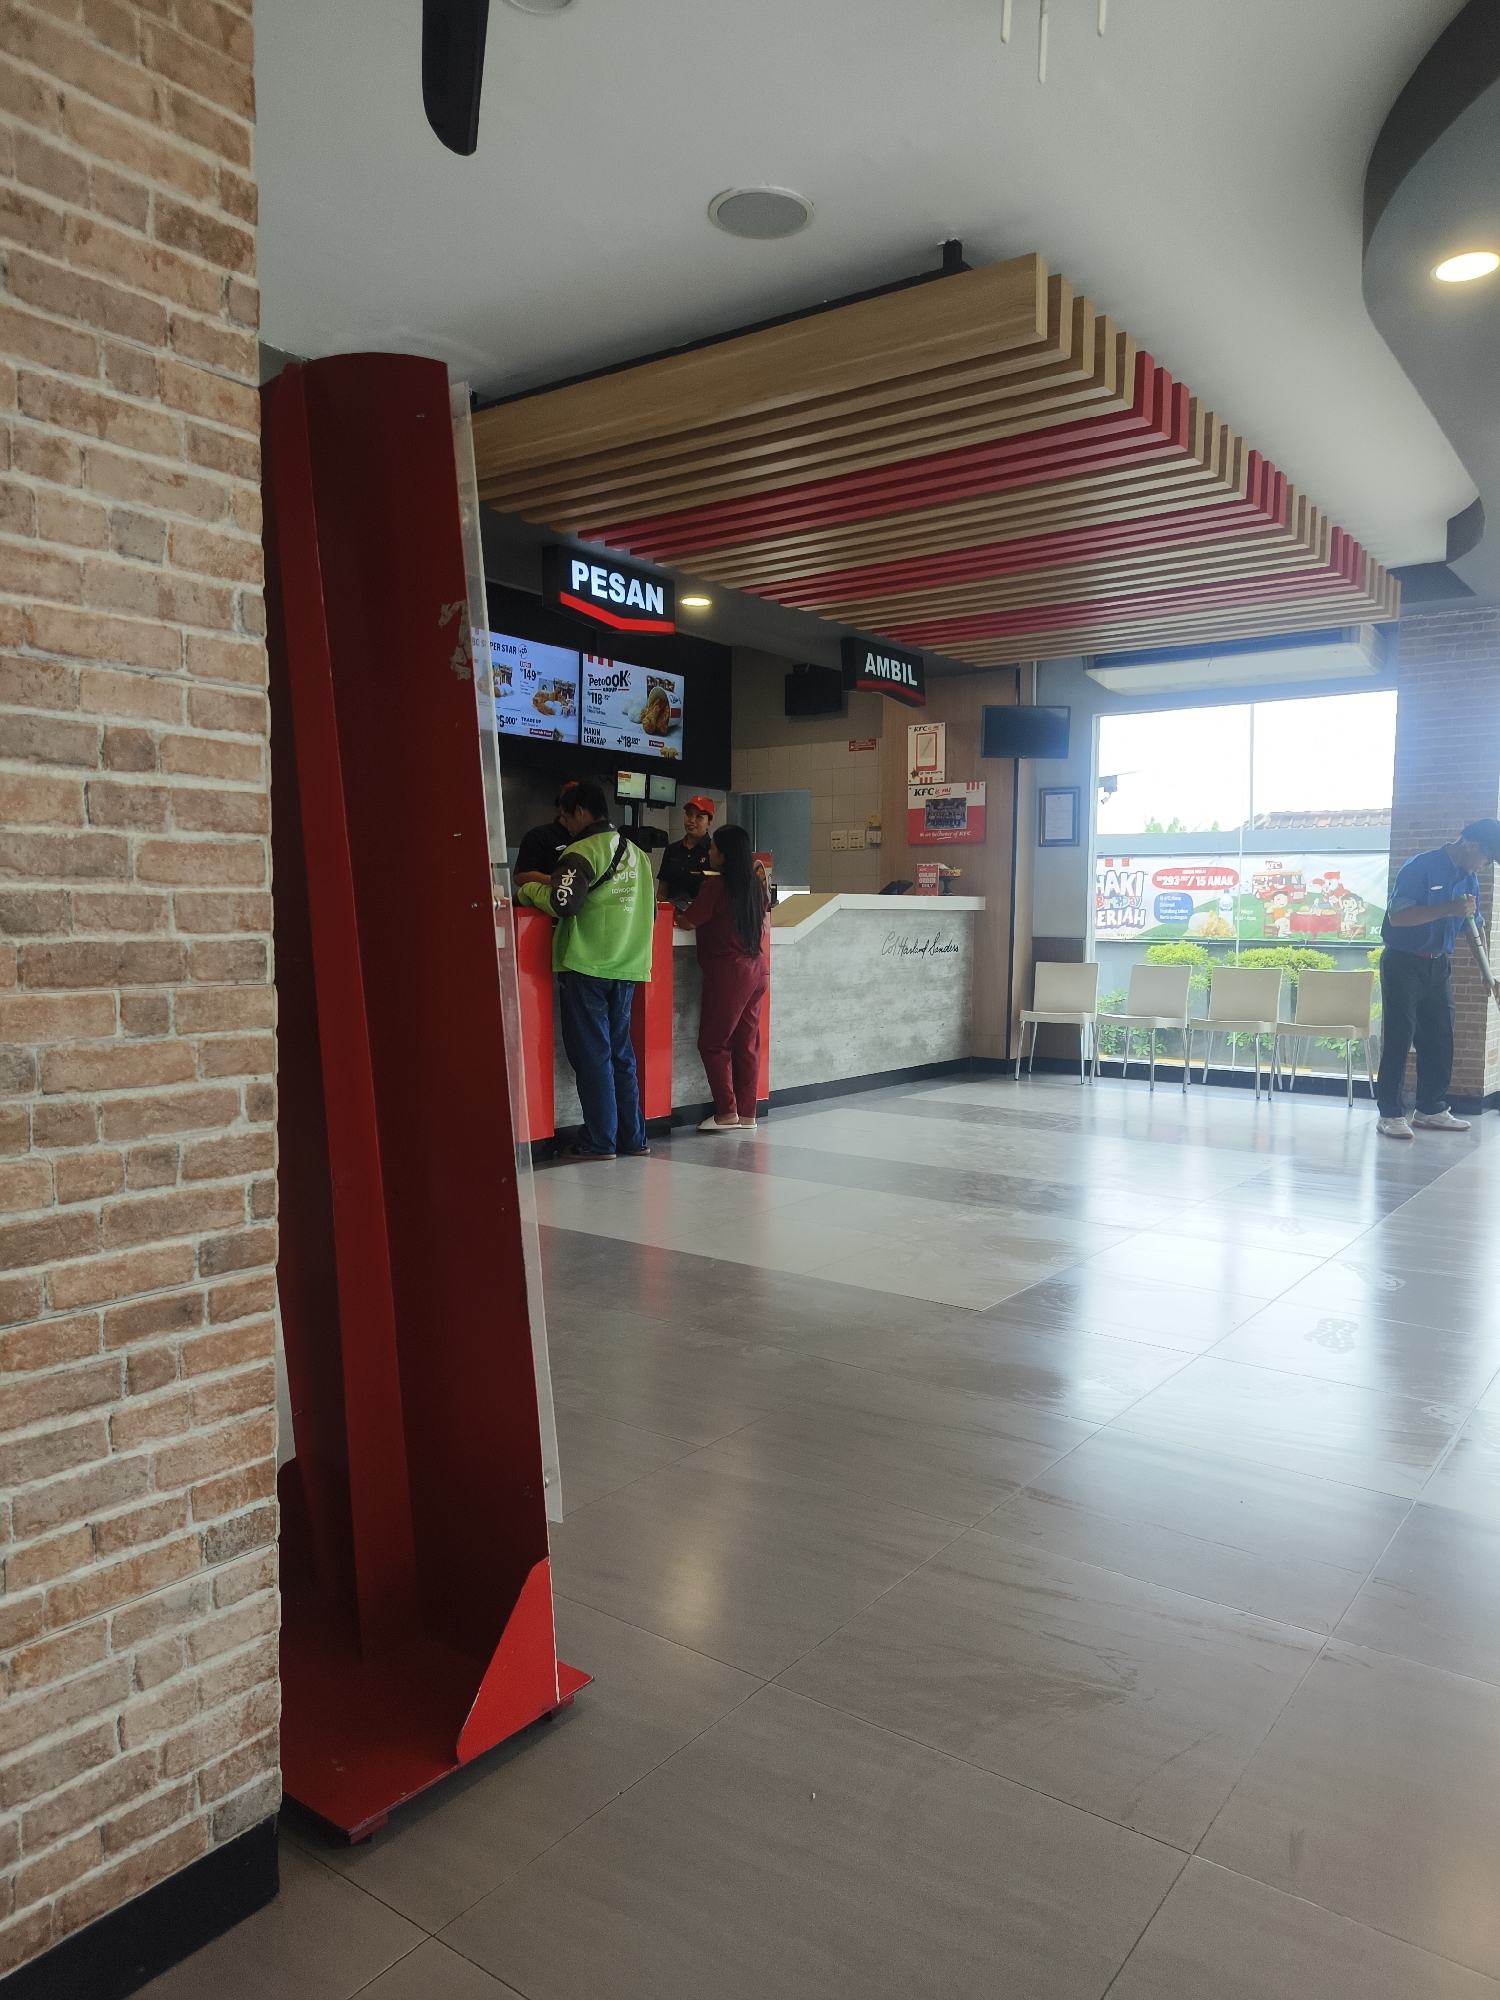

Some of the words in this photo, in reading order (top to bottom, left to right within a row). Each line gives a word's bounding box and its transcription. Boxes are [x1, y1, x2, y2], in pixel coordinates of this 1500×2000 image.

[571, 560, 664, 615] PESAN
[502, 644, 517, 655] STAR
[864, 653, 917, 686] AMBIL
[583, 735, 606, 745] LENGKAP
[914, 788, 934, 796] KFC
[1266, 861, 1282, 869] KFC
[1207, 876, 1234, 886] ANAK
[556, 868, 576, 906] gojek
